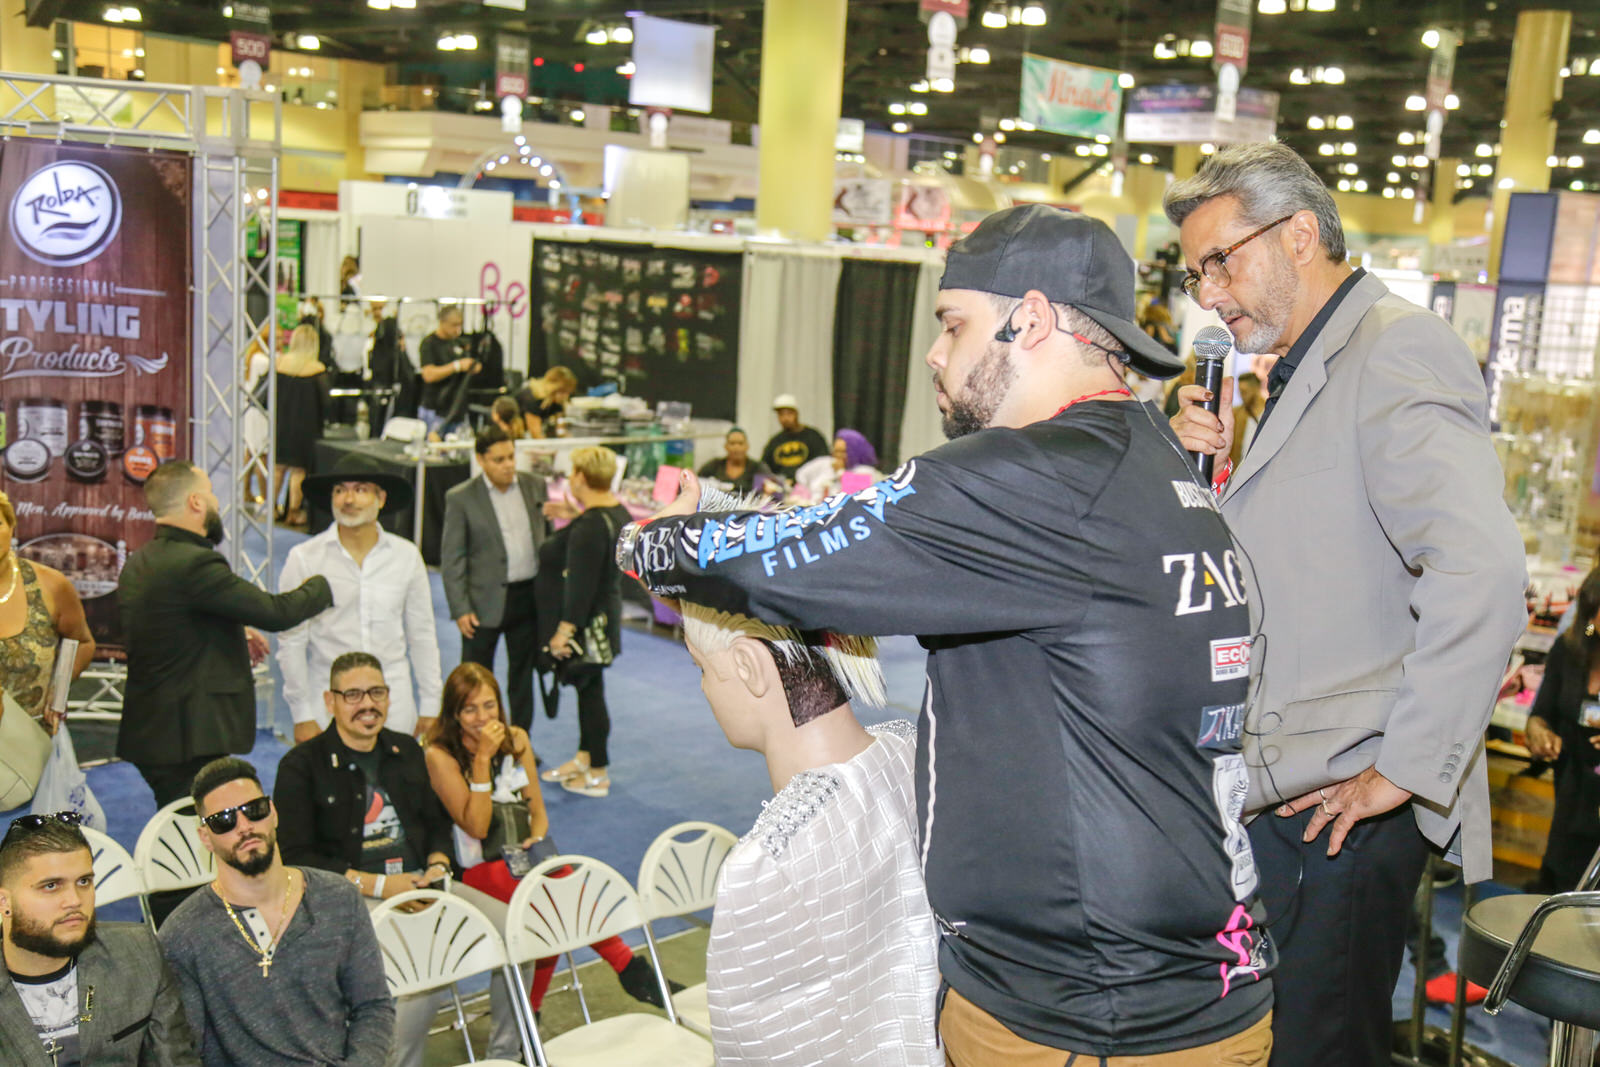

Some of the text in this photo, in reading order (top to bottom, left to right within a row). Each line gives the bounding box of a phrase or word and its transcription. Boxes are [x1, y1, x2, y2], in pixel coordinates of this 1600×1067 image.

[9, 274, 116, 297] PROFESSIONAL
[479, 261, 527, 318] Be
[0, 336, 127, 376] Products
[761, 515, 872, 578] FILMS
